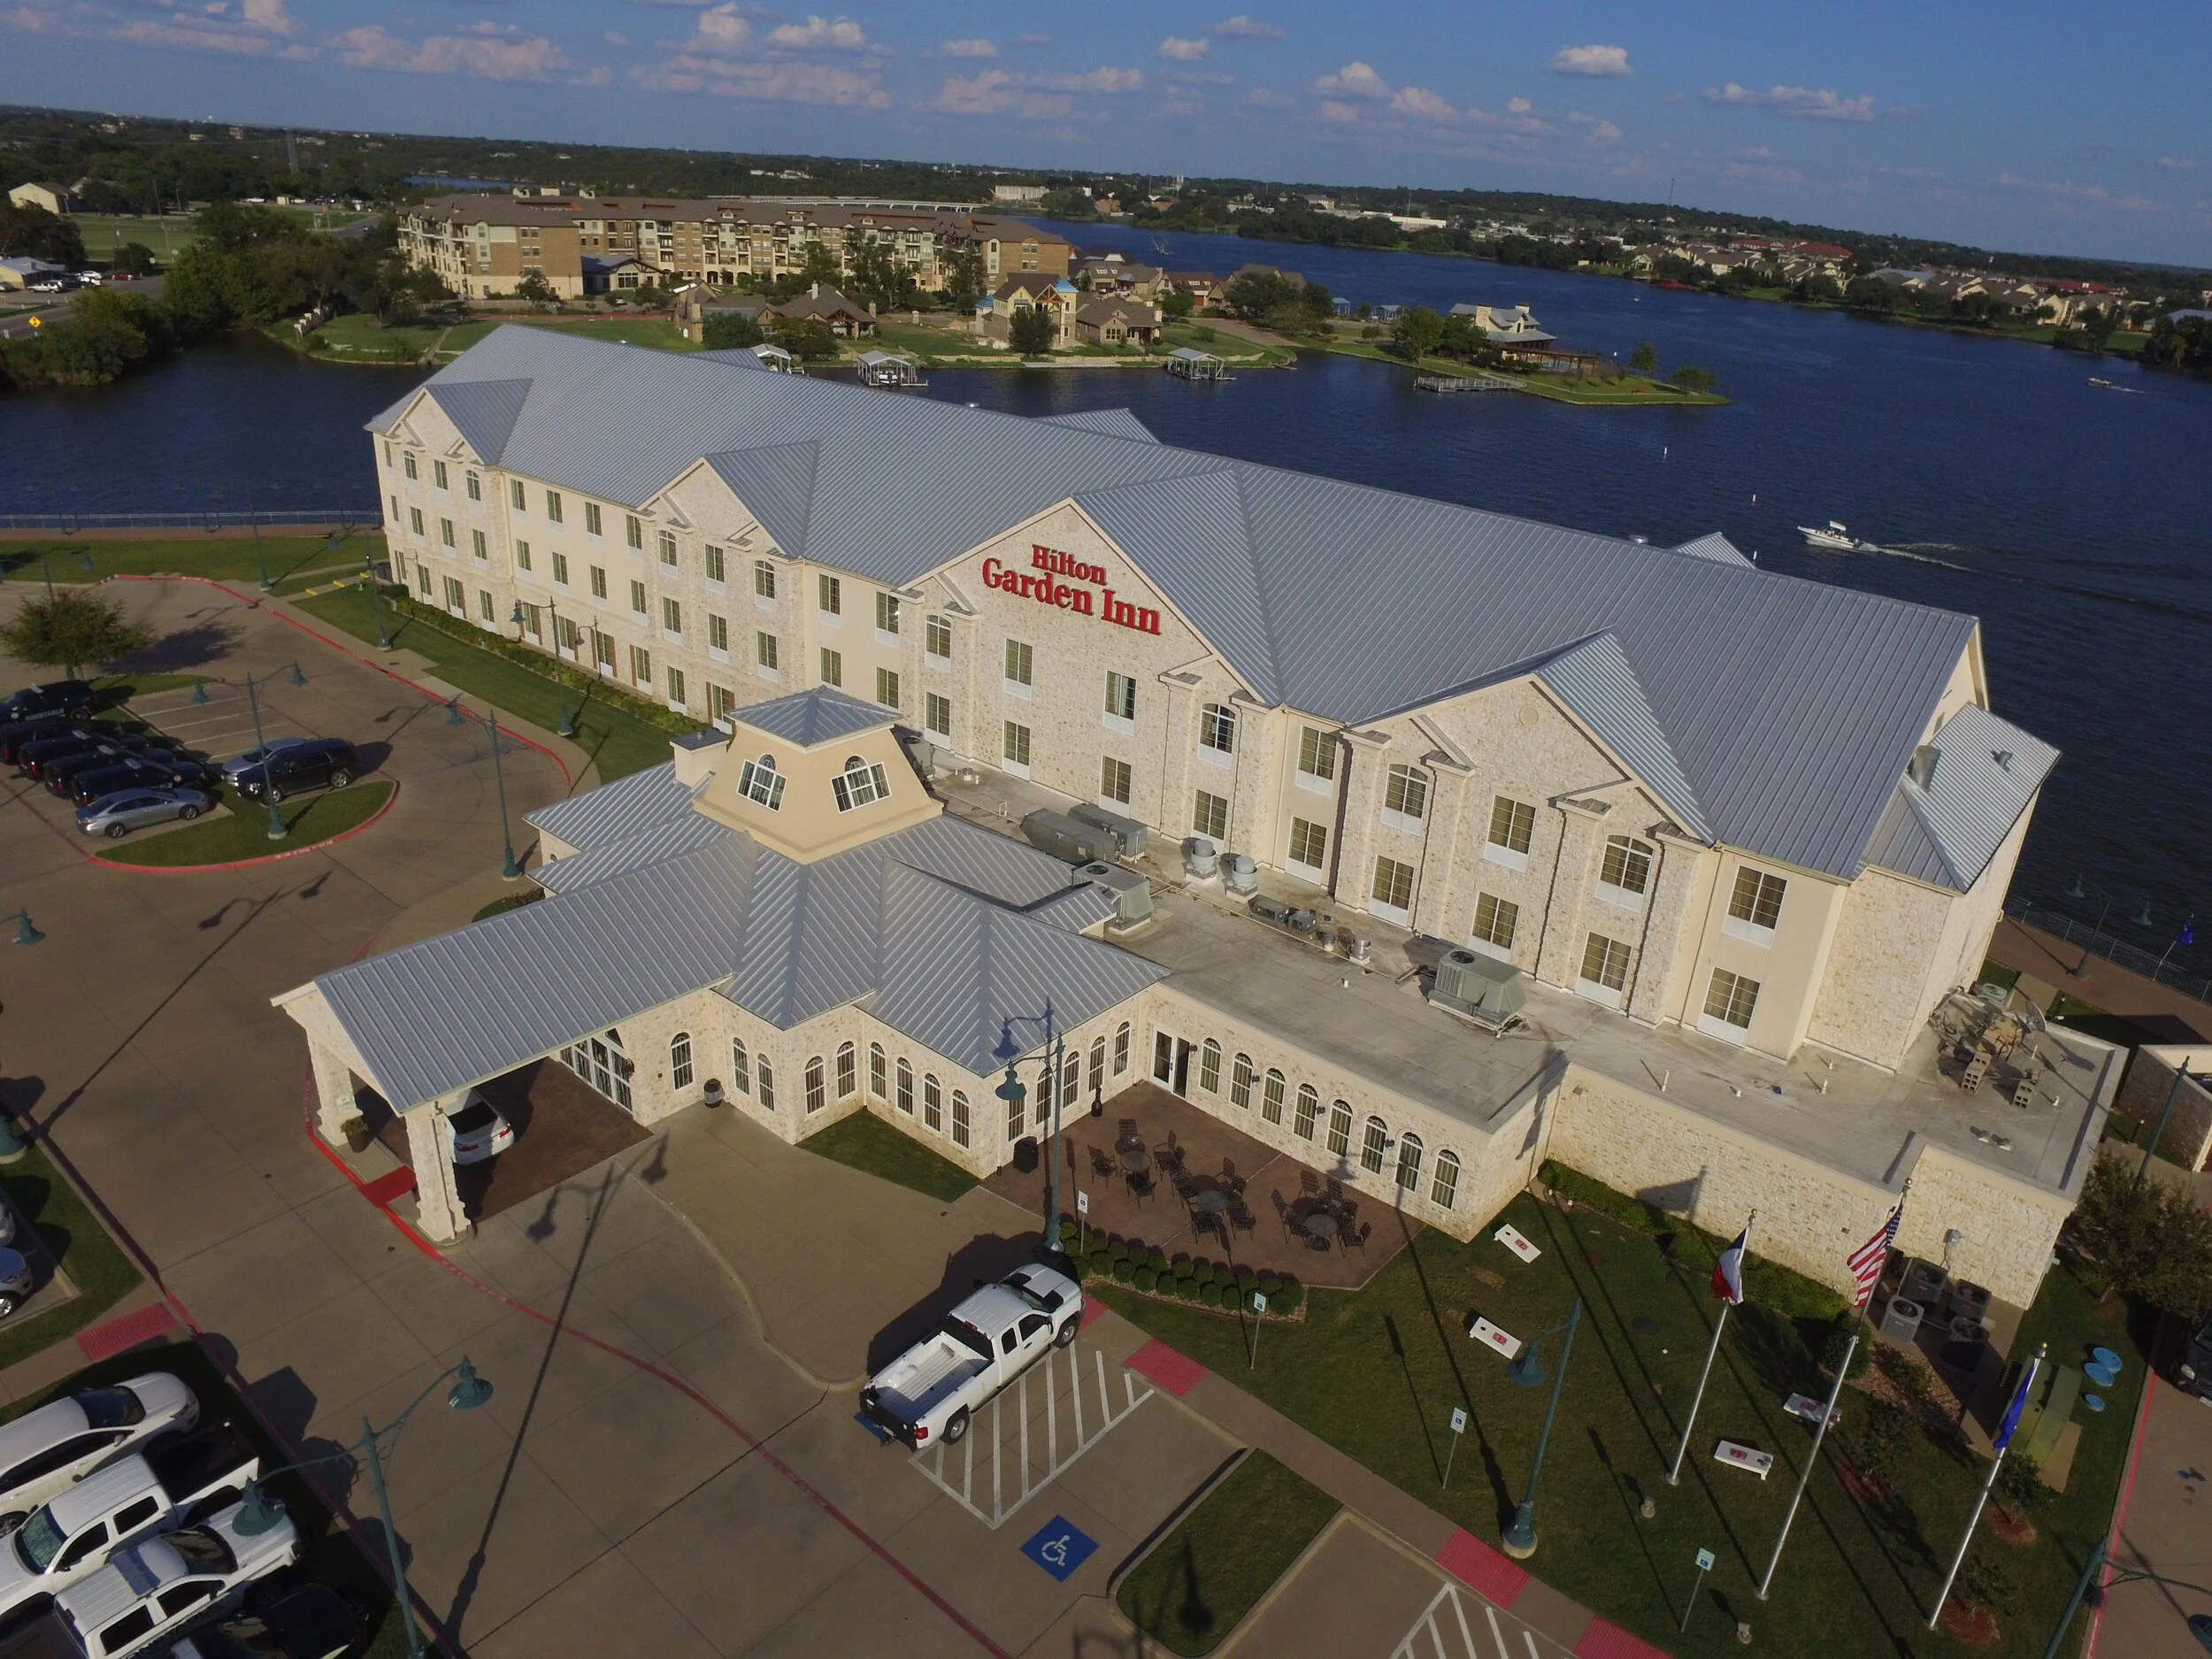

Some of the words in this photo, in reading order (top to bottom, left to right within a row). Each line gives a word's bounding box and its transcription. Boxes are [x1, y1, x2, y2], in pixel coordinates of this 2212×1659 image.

[1031, 544, 1108, 586] Hilton
[982, 557, 1094, 617] Garden
[1101, 588, 1162, 635] Inn
